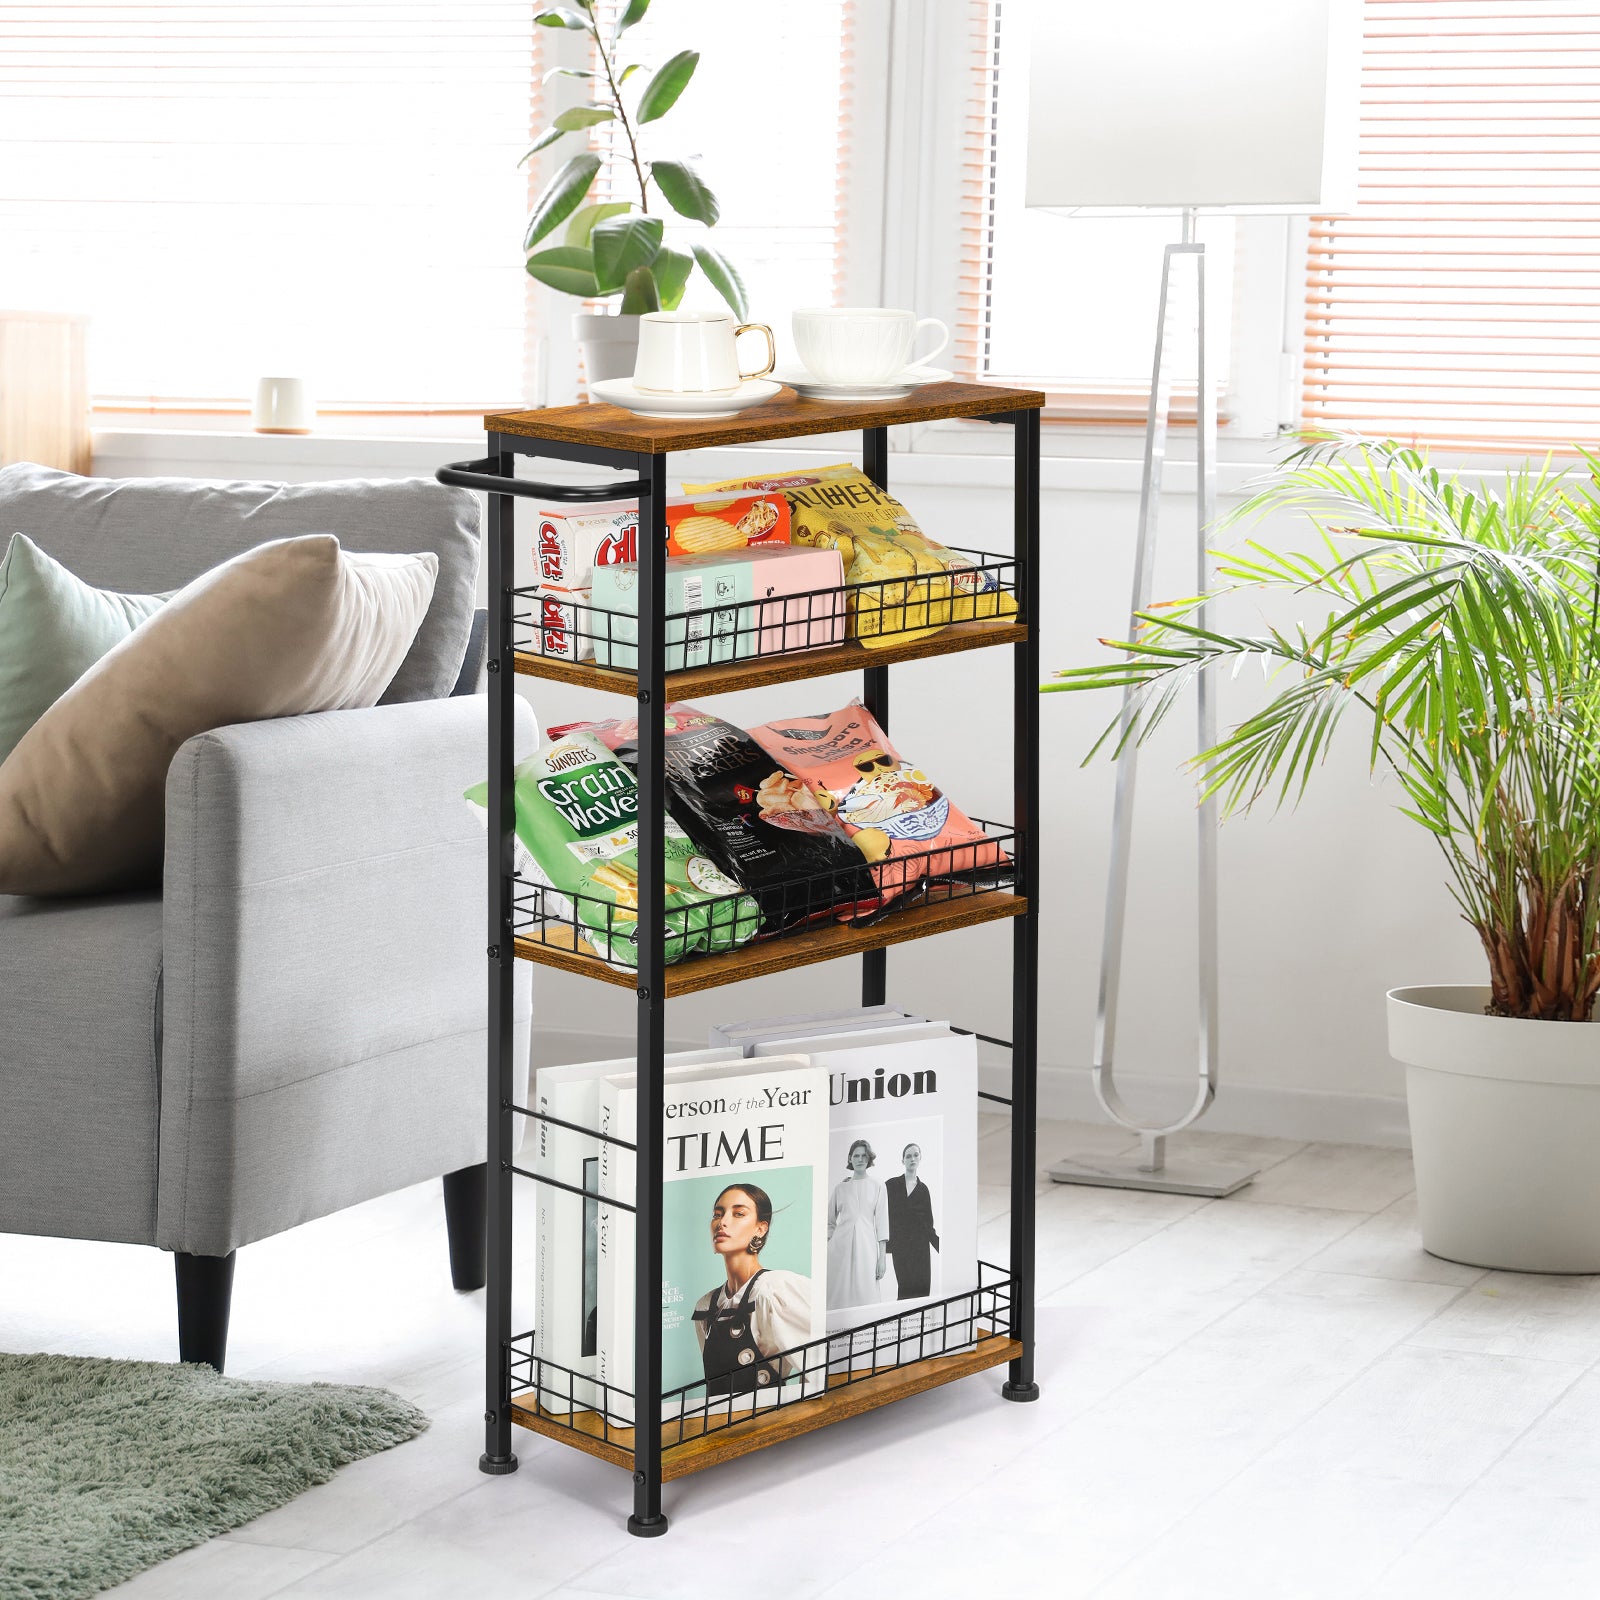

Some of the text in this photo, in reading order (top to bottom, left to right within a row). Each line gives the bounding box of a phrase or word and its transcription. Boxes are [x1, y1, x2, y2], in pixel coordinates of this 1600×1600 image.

[664, 734, 741, 773] HRIMP
[783, 722, 860, 755] Singapore
[545, 748, 597, 773] SUNBITES
[538, 767, 638, 806] Grain
[555, 794, 638, 831] Wave
[664, 1087, 812, 1119] erson of the Year
[827, 1068, 938, 1106] Union
[667, 1123, 785, 1172] TIME
